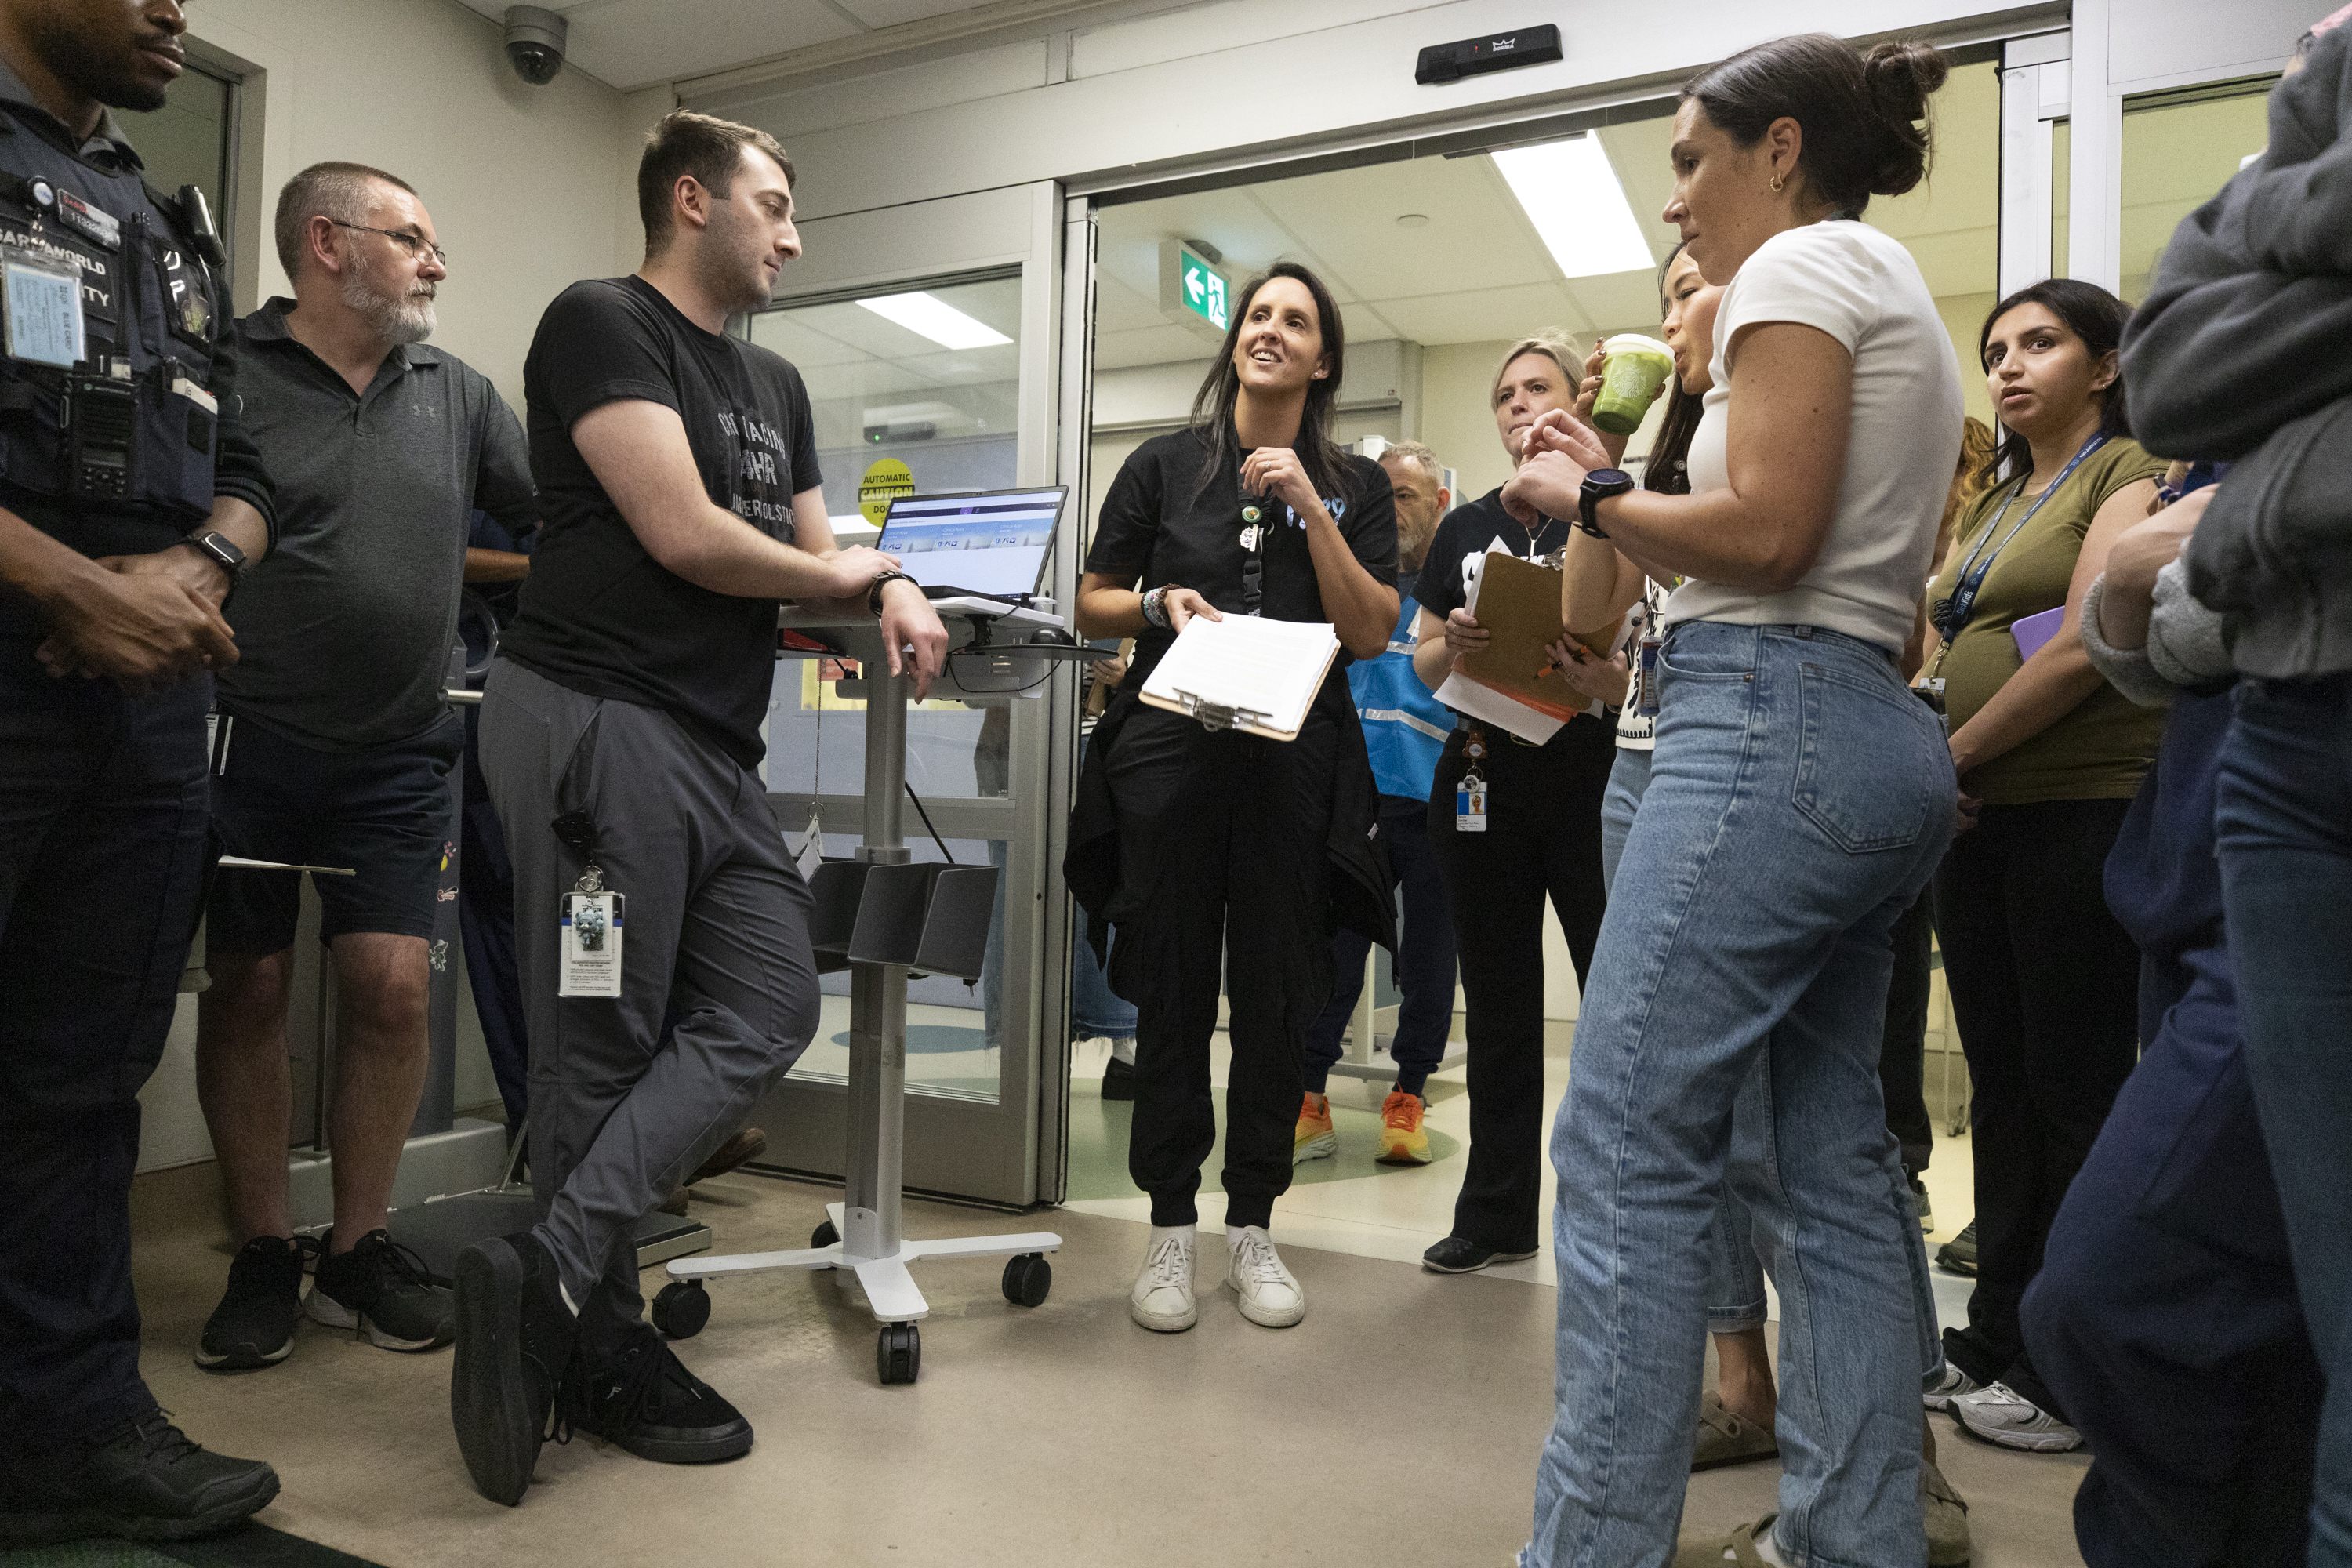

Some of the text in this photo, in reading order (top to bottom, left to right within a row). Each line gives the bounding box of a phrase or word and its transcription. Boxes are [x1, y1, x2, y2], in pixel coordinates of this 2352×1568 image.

[863, 474, 910, 484] AUTOMATIC
[861, 487, 913, 500] CAUTION
[1956, 590, 1973, 615] SickKids
